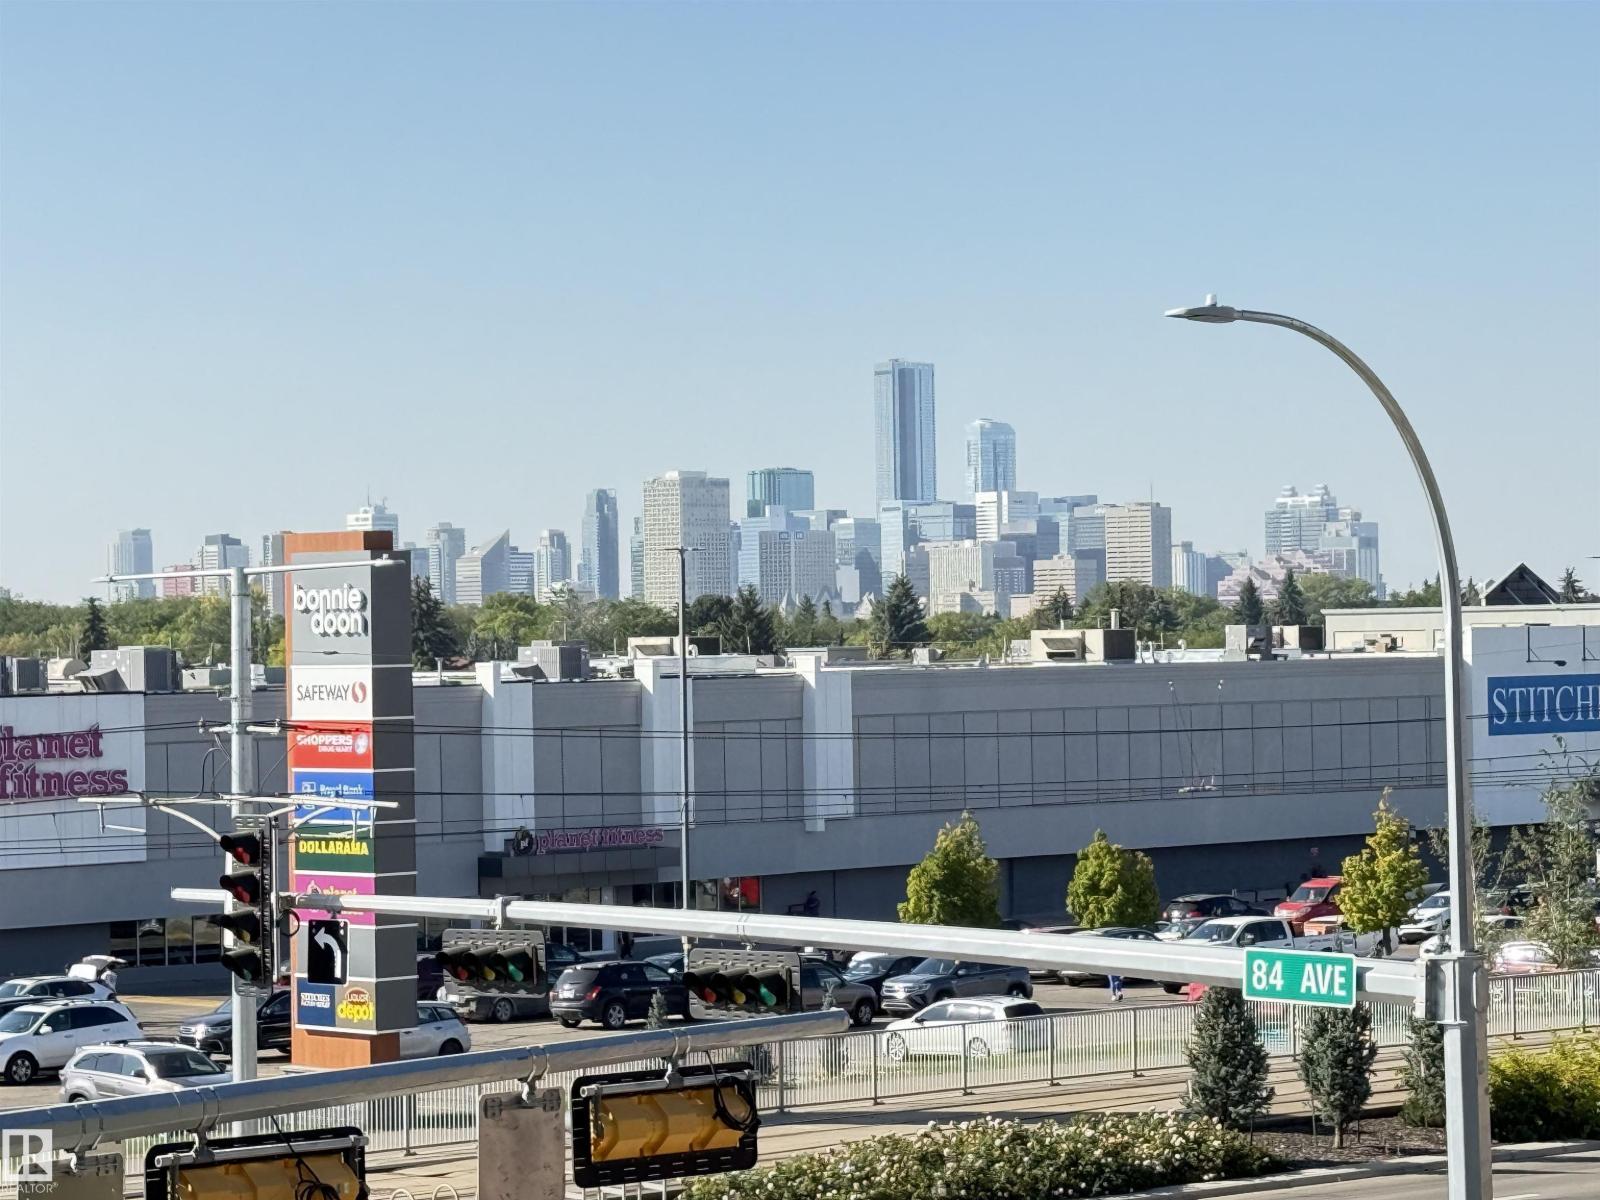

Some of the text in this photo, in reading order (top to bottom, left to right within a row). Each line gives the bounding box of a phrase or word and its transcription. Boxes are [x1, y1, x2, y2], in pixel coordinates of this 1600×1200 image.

[293, 583, 362, 615] bonnie
[311, 612, 363, 635] doon
[297, 684, 350, 701] SAFEWAY
[1492, 685, 1600, 725] STITCH
[296, 734, 353, 746] SHOPPERS
[0, 762, 129, 800] fitness
[299, 840, 369, 855] DOLLARAMA
[535, 826, 665, 855] planet fitness
[1252, 959, 1347, 996] 84 AVE
[337, 1001, 374, 1023] depot
